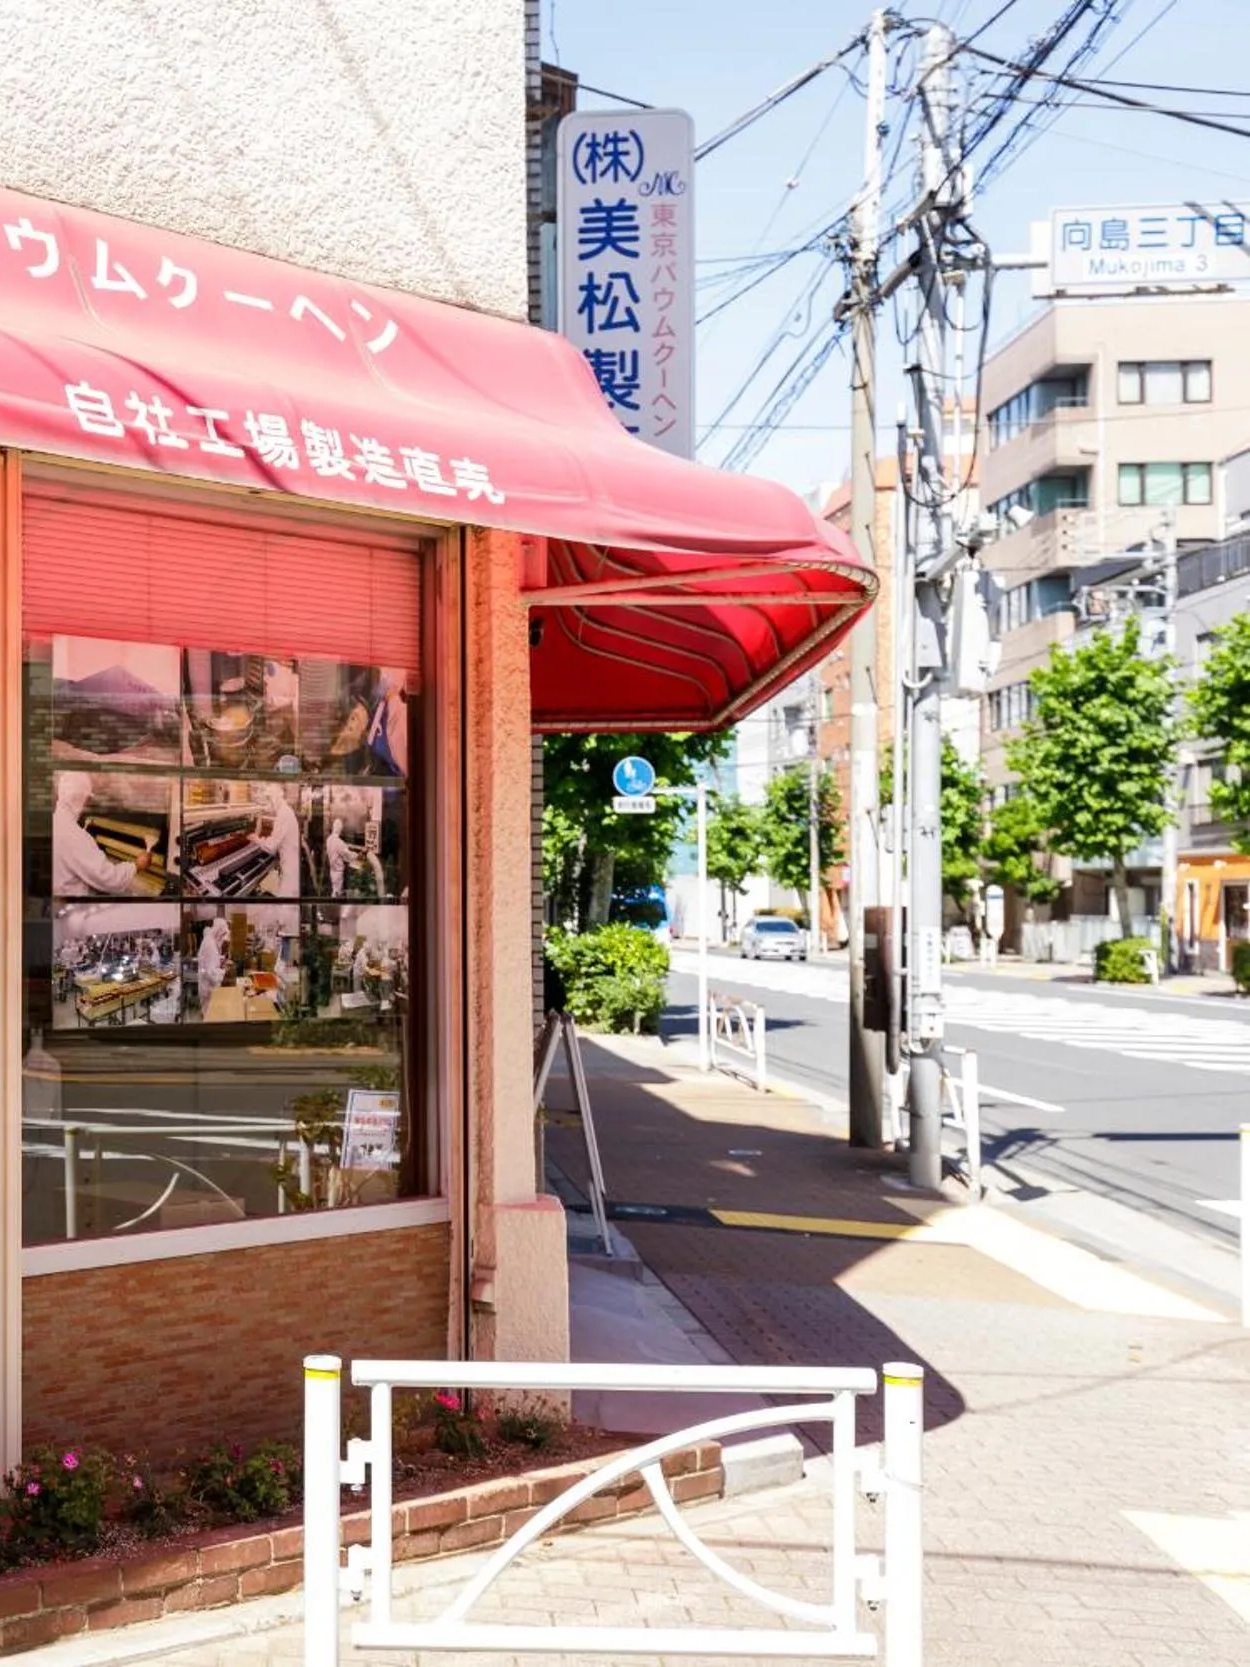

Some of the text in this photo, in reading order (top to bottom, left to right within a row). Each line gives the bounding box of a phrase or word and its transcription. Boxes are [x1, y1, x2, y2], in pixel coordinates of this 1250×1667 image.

[572, 129, 645, 434] (株)美松製
[1061, 213, 1246, 252] 向島三丁目
[1088, 255, 1209, 278] Mukojima 3
[650, 203, 678, 438] 東京バウムクーヘン
[64, 381, 506, 505] 自社工場製造直売
